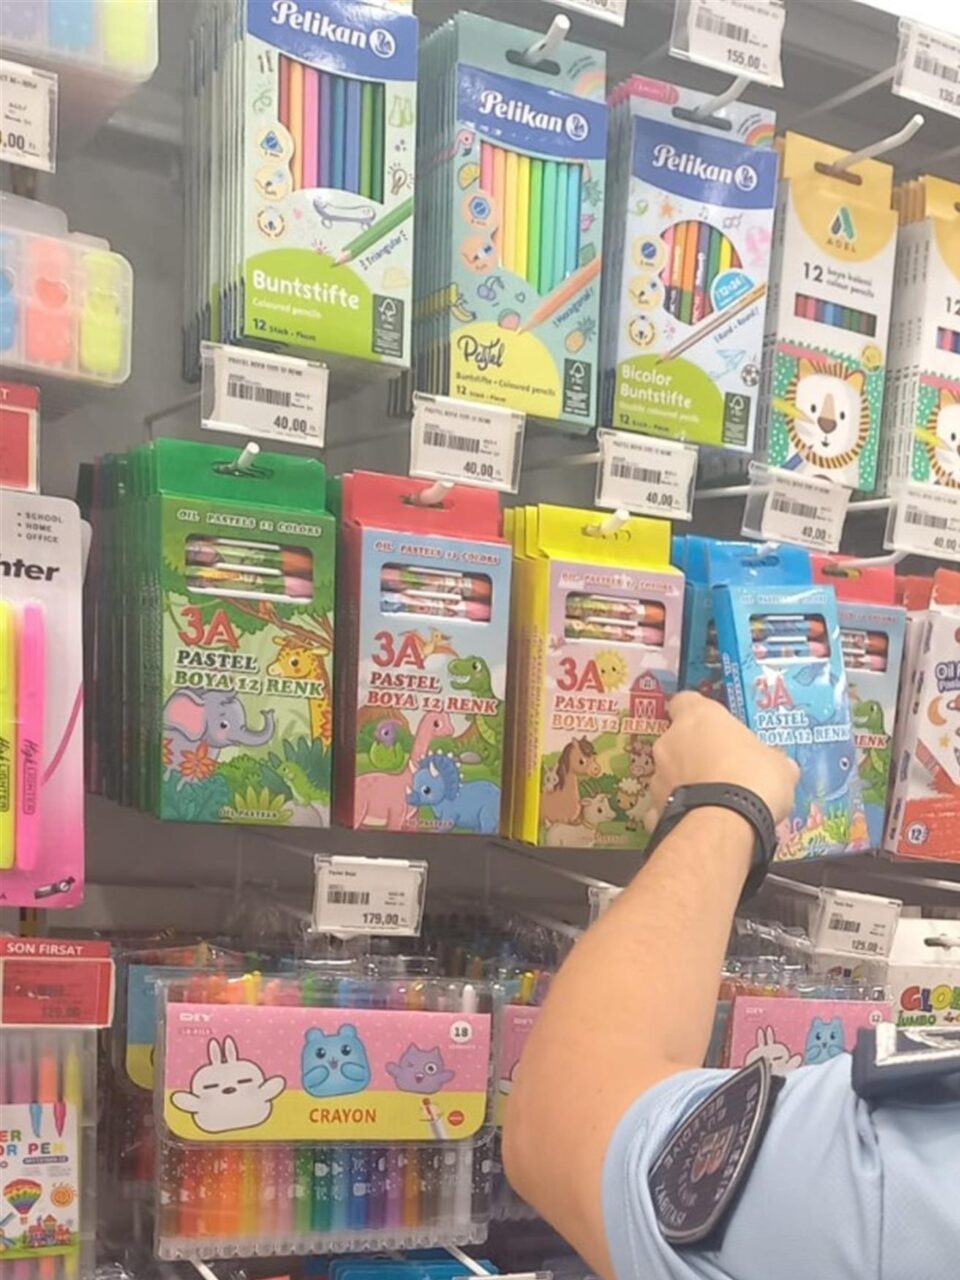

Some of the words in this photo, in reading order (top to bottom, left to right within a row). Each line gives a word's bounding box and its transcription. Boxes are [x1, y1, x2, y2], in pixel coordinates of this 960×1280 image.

[271, 0, 367, 48] Pelikan
[480, 90, 562, 133] Pelikan
[652, 144, 732, 184] Pelikan
[826, 237, 856, 253] ADEL
[803, 262, 824, 283] 12
[252, 269, 360, 309] Buntstifte
[253, 317, 267, 331] 12
[457, 335, 505, 371] Pastel
[622, 364, 672, 385] Bicolor
[456, 385, 467, 396] 12
[620, 382, 692, 409] Buntstifte
[206, 513, 256, 530] PASTELS
[277, 521, 322, 537] COLORS
[178, 604, 240, 650] 3A
[176, 650, 257, 671] PASTEL
[372, 631, 426, 669] 3A
[369, 671, 441, 691] PASTEL
[556, 656, 606, 694] 3A
[935, 661, 955, 683] Oil
[174, 671, 230, 690] BOYA
[237, 675, 264, 692] 12
[265, 679, 324, 698] RENK
[756, 674, 793, 711] 3A
[367, 690, 417, 709] BOYA
[421, 696, 444, 712] 12
[446, 696, 497, 716] RENK
[554, 695, 619, 714] PASTEL
[552, 714, 597, 730] BOYA
[600, 717, 618, 733] 12
[623, 717, 668, 735] RENK
[757, 712, 808, 728] PASTEL
[815, 725, 851, 741] RENK
[910, 828, 923, 841] 12
[6, 943, 36, 954] SON
[40, 944, 83, 955] FIRSAT
[896, 1011, 936, 1027] JUMBO
[454, 1027, 468, 1037] 18
[309, 1108, 377, 1123] CRAYON
